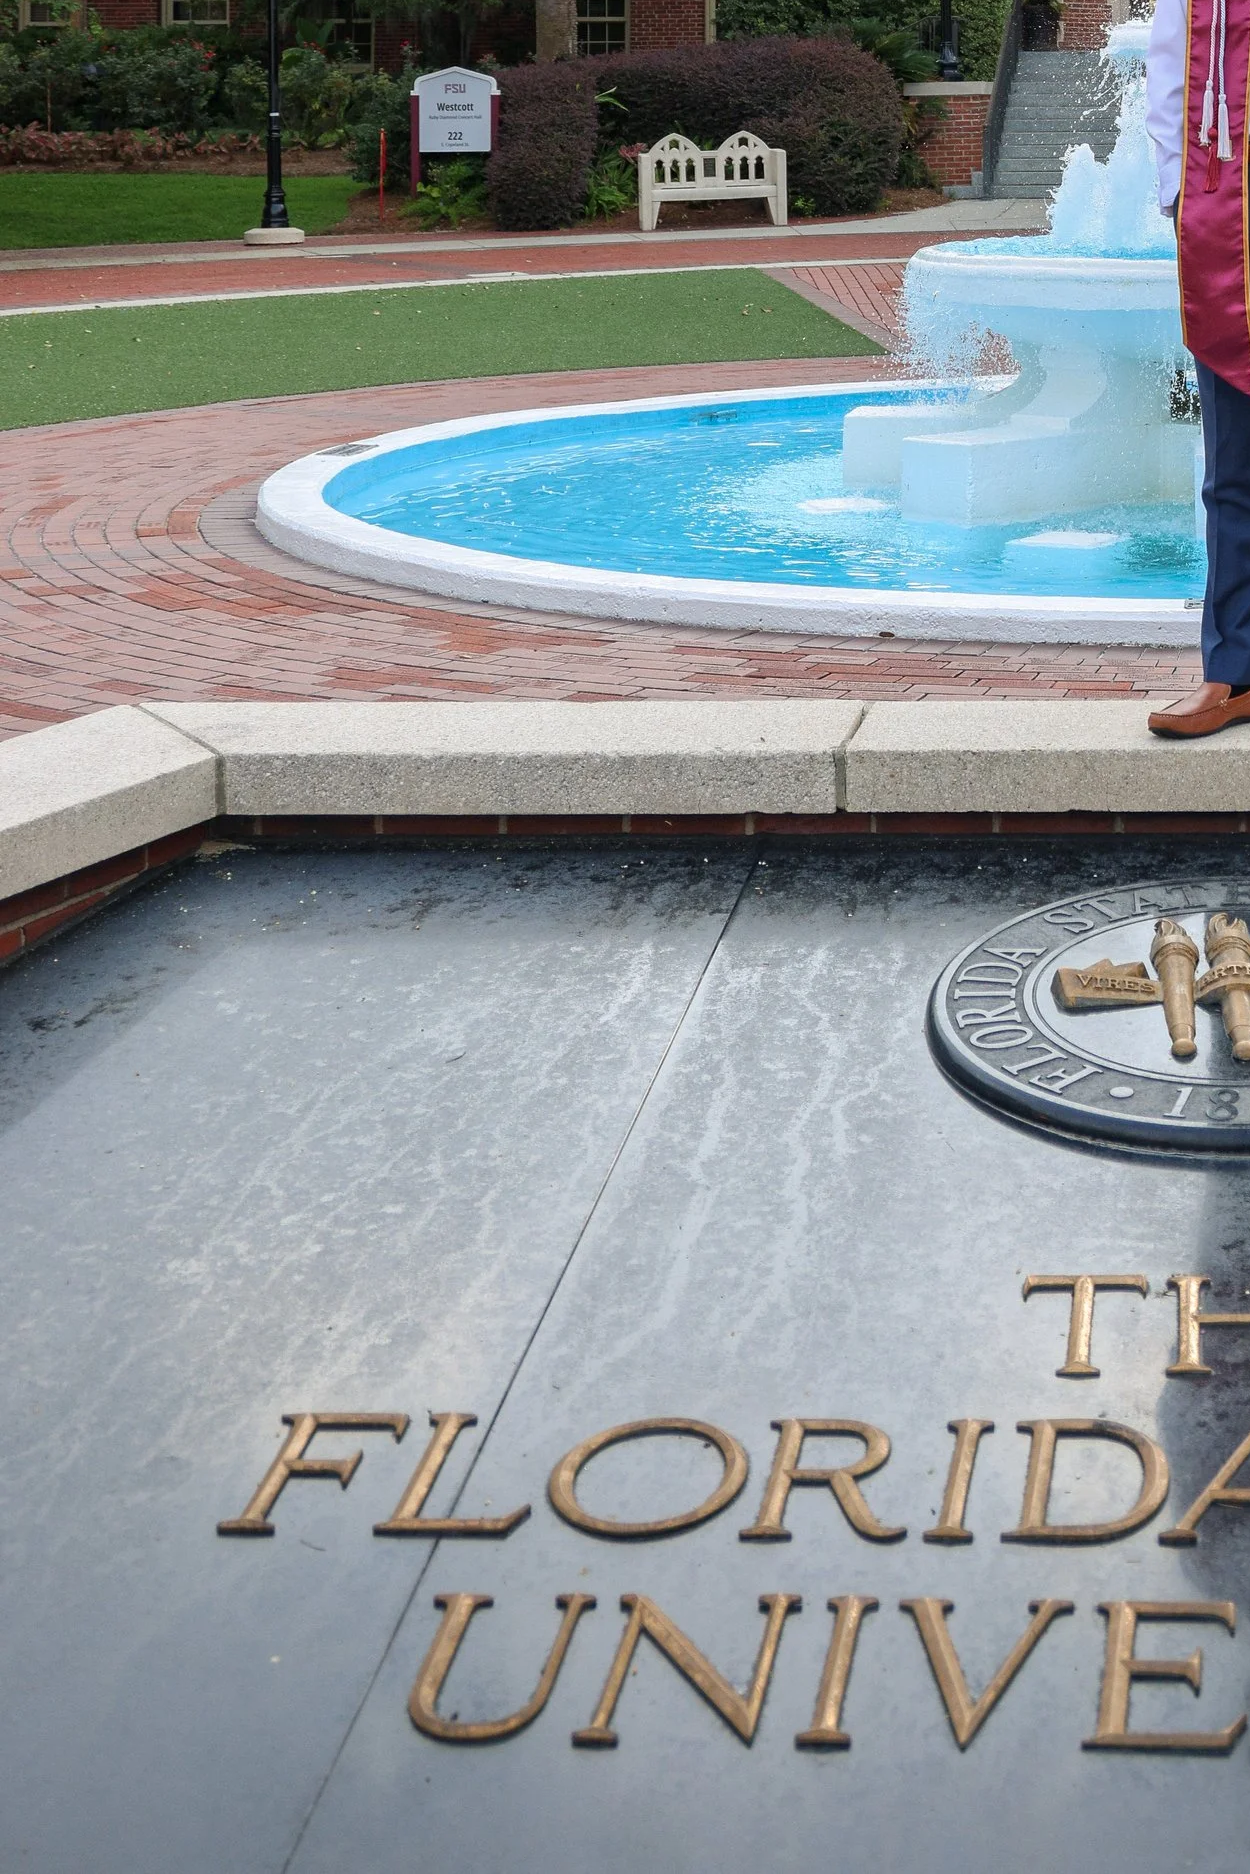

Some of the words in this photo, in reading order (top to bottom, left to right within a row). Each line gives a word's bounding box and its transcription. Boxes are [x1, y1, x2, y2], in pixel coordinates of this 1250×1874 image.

[444, 83, 466, 94] FSU
[436, 102, 474, 112] Westcott
[447, 131, 463, 141] 222
[1075, 972, 1156, 995] VIRES
[953, 946, 1104, 1095] FLORIDA
